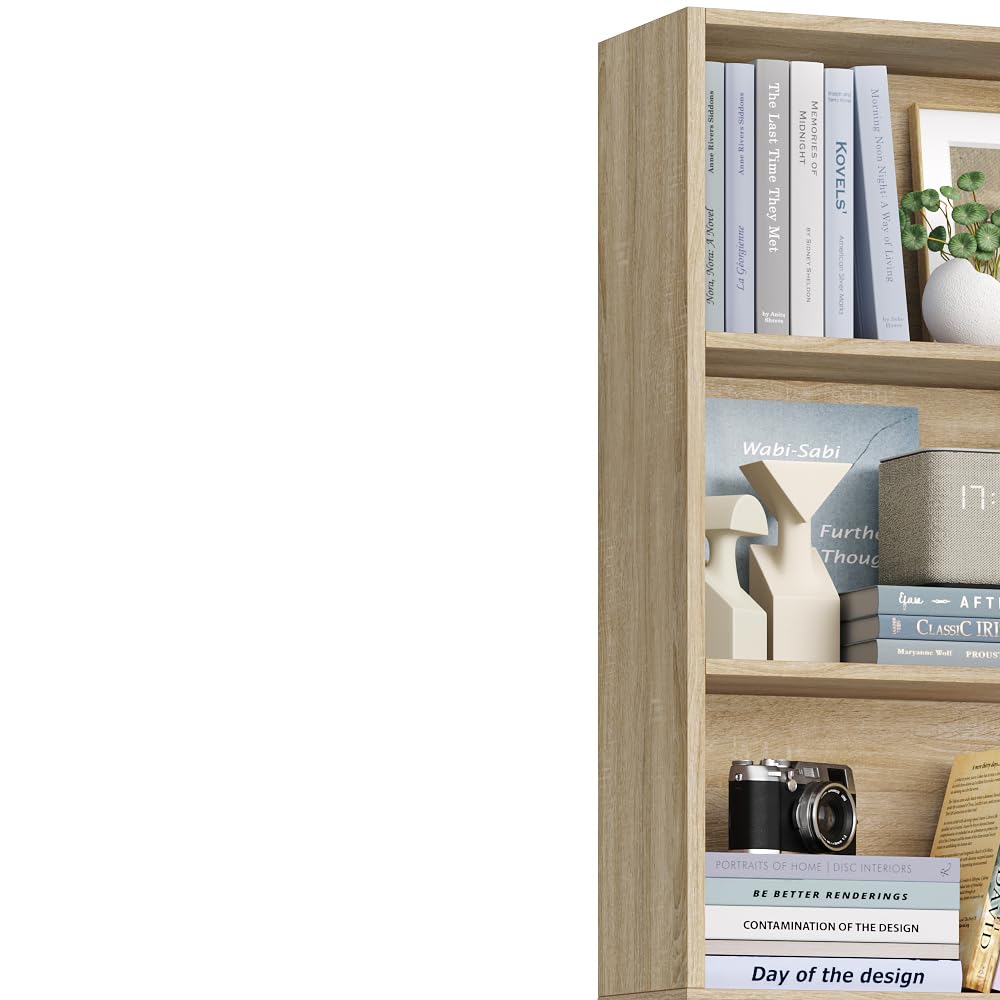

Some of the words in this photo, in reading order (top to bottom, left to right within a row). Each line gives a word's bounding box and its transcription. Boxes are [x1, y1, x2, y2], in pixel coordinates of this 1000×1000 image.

[707, 91, 715, 123] Siddons
[768, 83, 780, 109] The
[870, 89, 881, 132] Morning
[707, 125, 715, 151] Rivers
[768, 114, 780, 144] Last
[799, 110, 807, 165] MIDNIGHT
[811, 101, 819, 159] MEMORIES
[875, 137, 884, 162] Noon
[707, 153, 715, 173] Anne
[768, 148, 780, 182] Time
[811, 162, 819, 176] OF
[836, 142, 847, 215] KOVELS'
[766, 188, 780, 221] They
[880, 201, 888, 209] A
[705, 207, 715, 236] Novel
[806, 228, 812, 236] BY
[880, 212, 890, 233] Way
[705, 237, 715, 248] A
[768, 226, 780, 252] Met
[883, 236, 892, 246] of
[705, 250, 715, 276] Nora:
[884, 250, 895, 282] Living
[705, 279, 715, 305] Nora,
[736, 277, 745, 290] La
[743, 442, 840, 459] Wabi-Sabi
[916, 619, 972, 637] CLASSIC
[897, 648, 933, 658] Maryanne
[935, 649, 953, 657] Wolf
[716, 860, 768, 870] PORTRAITS
[772, 861, 787, 871] OF
[791, 862, 822, 872] HOME
[833, 863, 857, 873] DISC
[860, 864, 912, 874] INTERIORS
[753, 889, 768, 897] BE
[773, 890, 820, 899] BETTER
[826, 891, 908, 901] RENDERINGS
[743, 920, 836, 931] CONTAMINATION
[839, 922, 853, 931] OF
[855, 923, 876, 932] THE
[879, 924, 919, 933] DESIGN
[752, 966, 790, 985] Day
[796, 966, 818, 983] of
[822, 967, 854, 983] the
[860, 968, 925, 988] design
